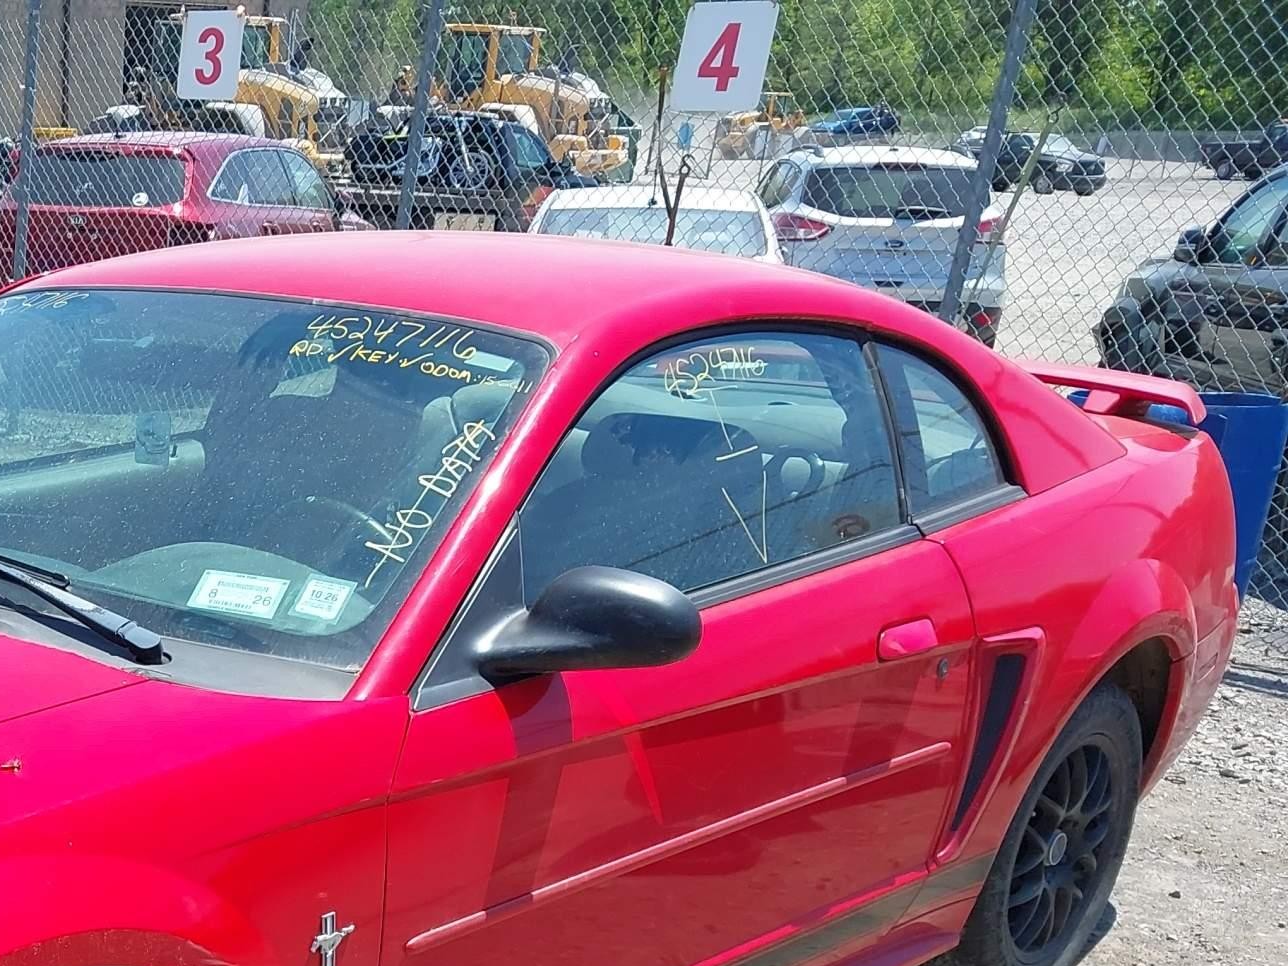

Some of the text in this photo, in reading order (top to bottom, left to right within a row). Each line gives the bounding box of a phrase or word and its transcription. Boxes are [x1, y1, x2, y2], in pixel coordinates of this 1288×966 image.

[194, 27, 225, 85] 3
[697, 22, 741, 92] 4
[308, 315, 476, 360] 45247116
[365, 419, 496, 563] NO DATA
[252, 594, 272, 607] 26
